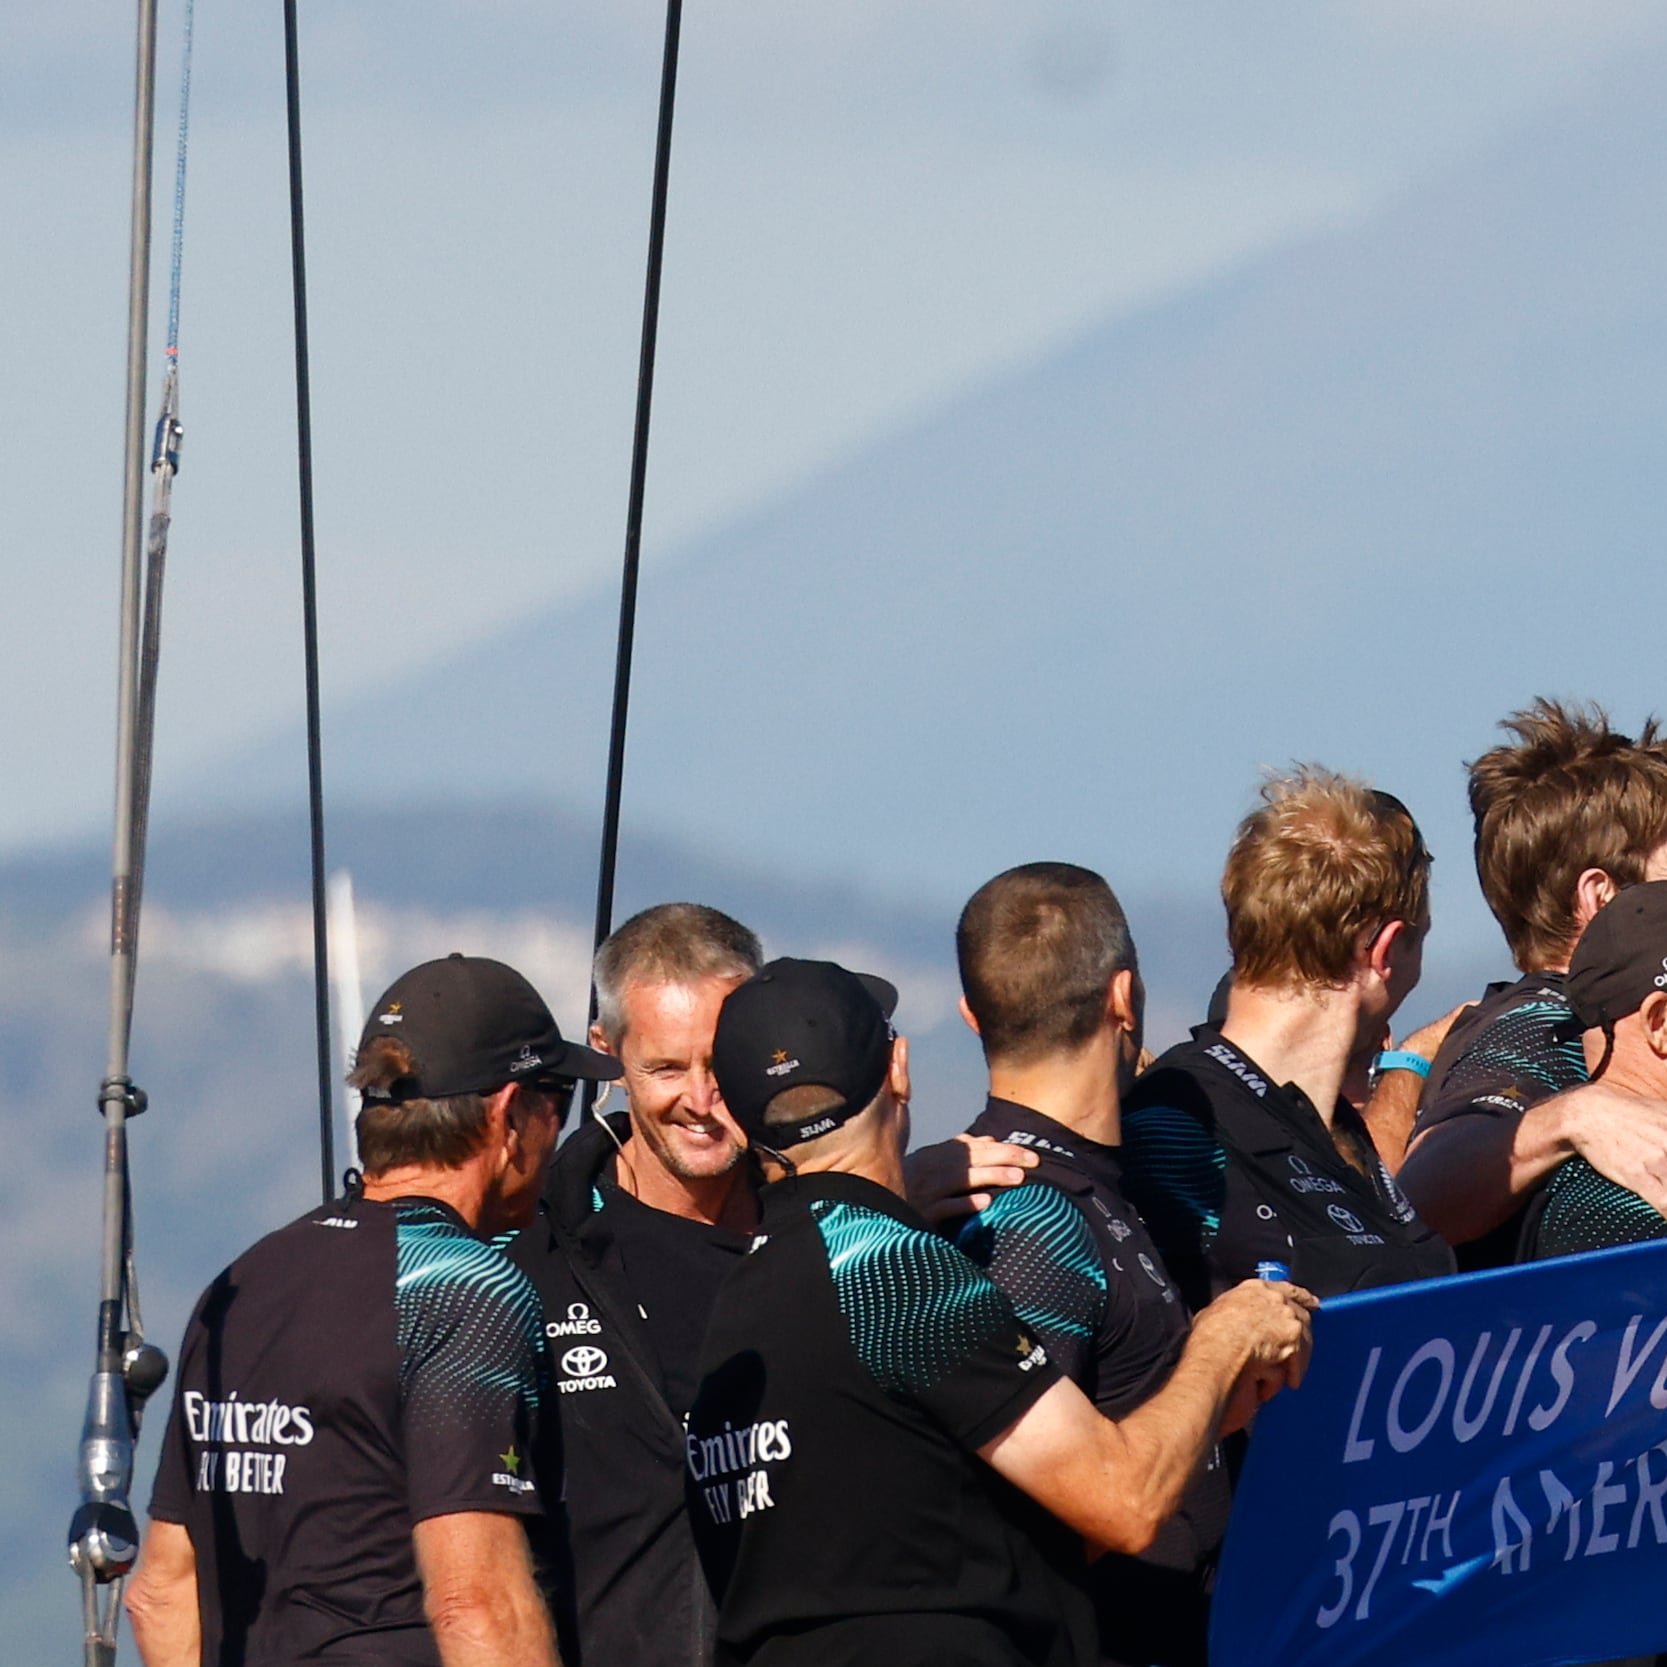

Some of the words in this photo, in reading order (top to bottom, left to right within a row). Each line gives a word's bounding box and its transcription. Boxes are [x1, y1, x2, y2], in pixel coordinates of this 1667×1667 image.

[800, 1117, 837, 1139] SLAM
[1290, 1177, 1346, 1194] OMEGA
[546, 1319, 602, 1338] OMEG
[557, 1375, 617, 1394] TOYOTA
[1343, 1320, 1598, 1464] LOUIS
[183, 1390, 314, 1446] Emirates
[1316, 1489, 1461, 1629] 37TH
